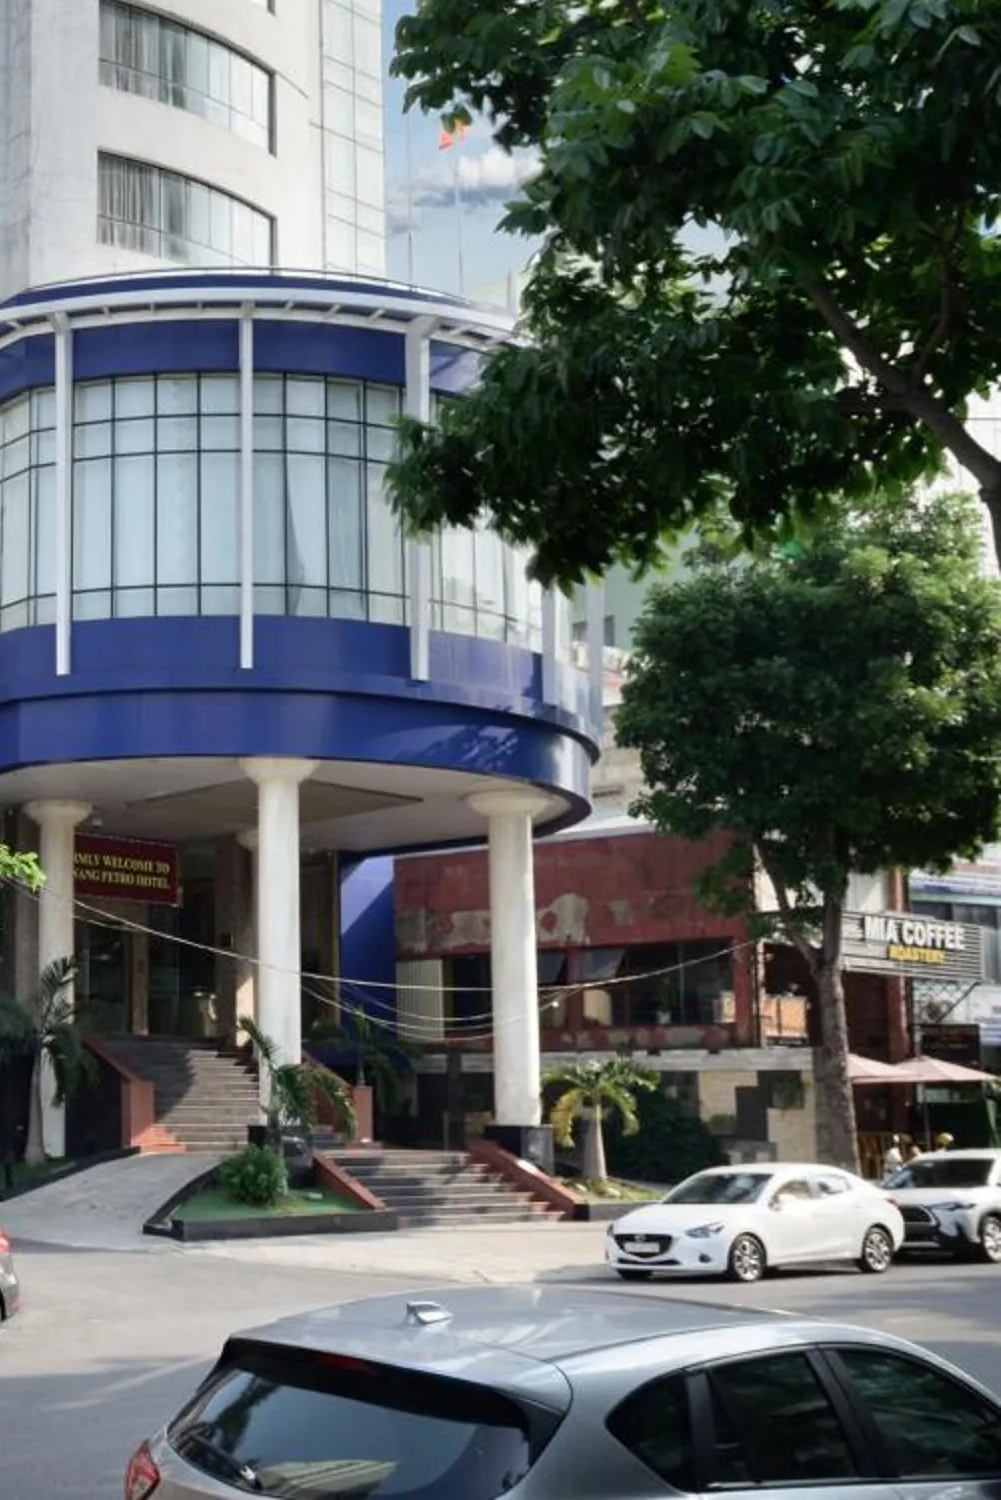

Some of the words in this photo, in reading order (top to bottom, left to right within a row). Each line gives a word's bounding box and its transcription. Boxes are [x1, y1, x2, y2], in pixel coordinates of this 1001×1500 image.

[102, 855, 153, 873] WELCOME
[155, 861, 170, 874] TO
[102, 870, 135, 885] PETRO
[136, 875, 170, 889] HOTEL
[864, 915, 899, 943] MIA
[902, 920, 966, 950] COFFEE
